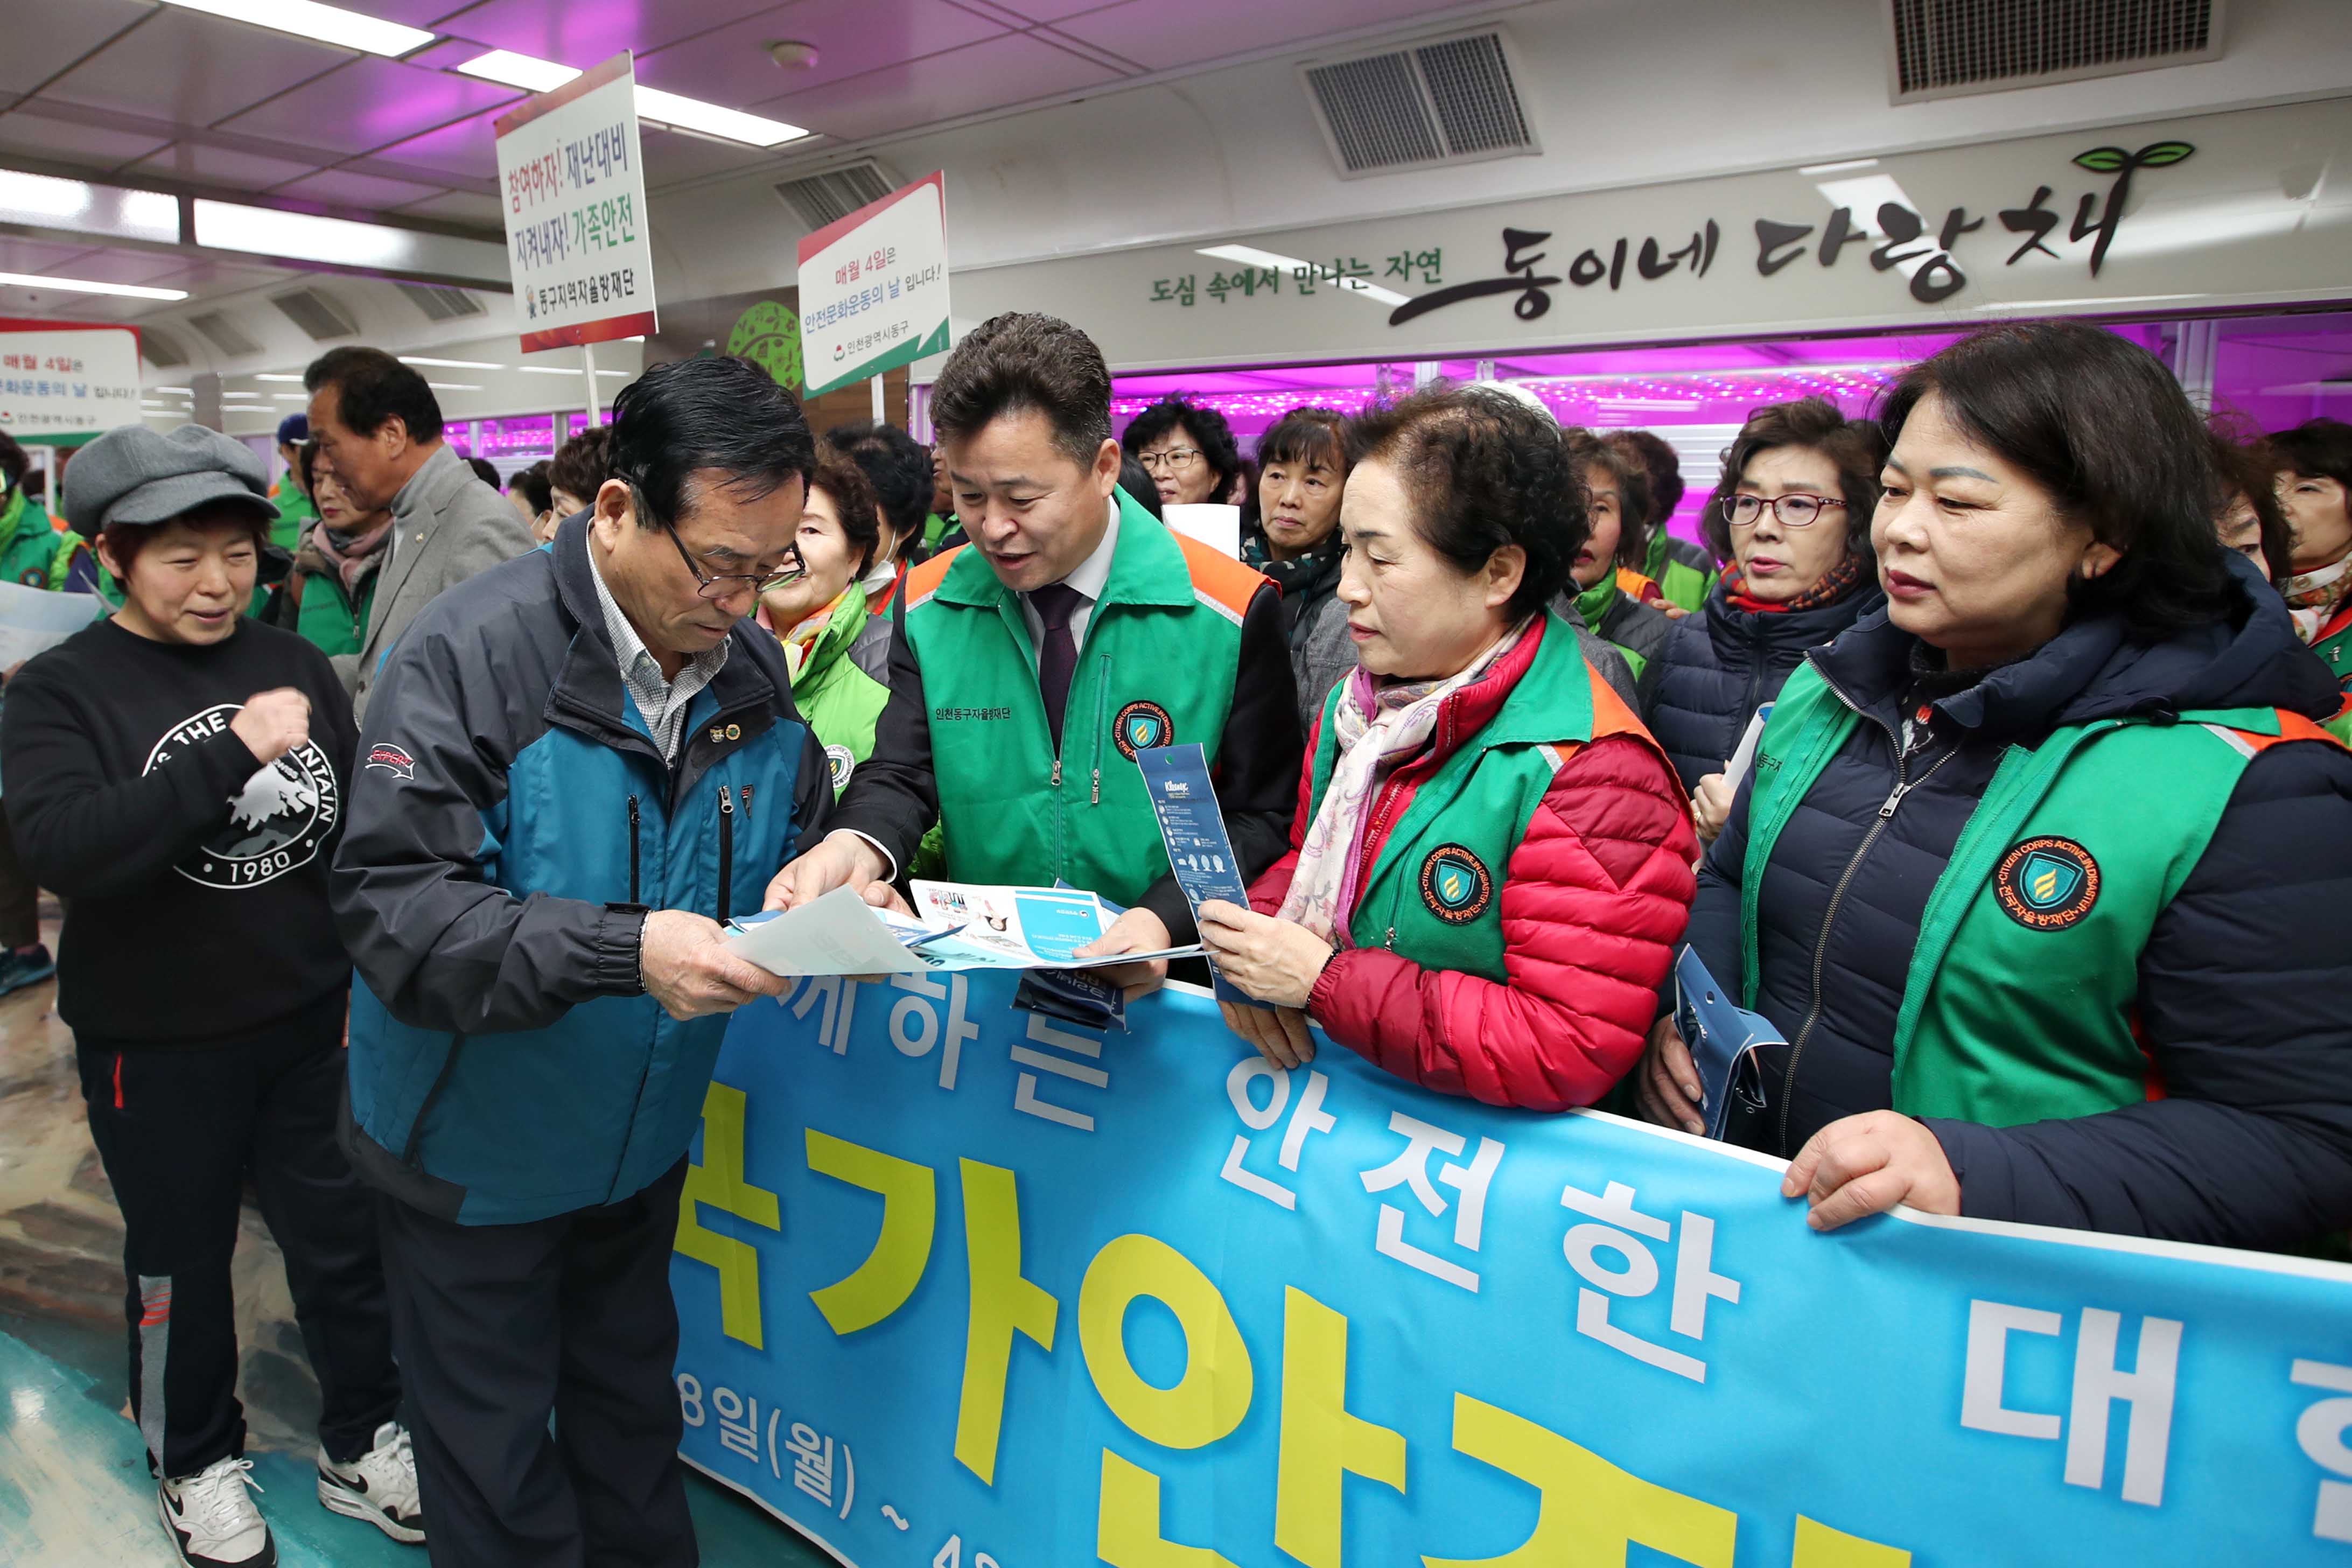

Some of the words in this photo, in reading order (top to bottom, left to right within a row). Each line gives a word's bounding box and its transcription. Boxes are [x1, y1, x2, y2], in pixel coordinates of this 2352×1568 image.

[508, 139, 563, 213] 참여하자!
[565, 123, 628, 188] 재난대비
[515, 213, 570, 271] 지켜내자!
[572, 193, 635, 255] 가족안전
[1389, 220, 1720, 326] 동이네
[1755, 162, 2135, 303] 다랑채
[539, 268, 635, 316] 동구지역자율방재단
[836, 258, 860, 285] 매월
[865, 246, 896, 272] 4일은
[1150, 274, 1195, 306] 도심
[1206, 265, 1279, 303] 속에서
[1293, 257, 1374, 295] 만나는
[1385, 248, 1443, 284] 자연
[805, 283, 884, 334] 안전문화운동의
[888, 276, 900, 299] 날
[905, 263, 941, 292] 입니다!
[847, 320, 909, 355] 인천광역시동구
[173, 712, 227, 745] THE
[230, 851, 290, 883] 1980
[1422, 859, 1434, 886] CITIZEN
[1431, 848, 1451, 862] CORPS
[1451, 848, 1475, 865] ACTIVE
[1998, 850, 2022, 880] CITIZEN
[2020, 839, 2054, 853] CORPS
[2054, 841, 2088, 862] ACTIVE
[2077, 868, 2098, 912] DISASTER
[1220, 1056, 1741, 1384] 안전한
